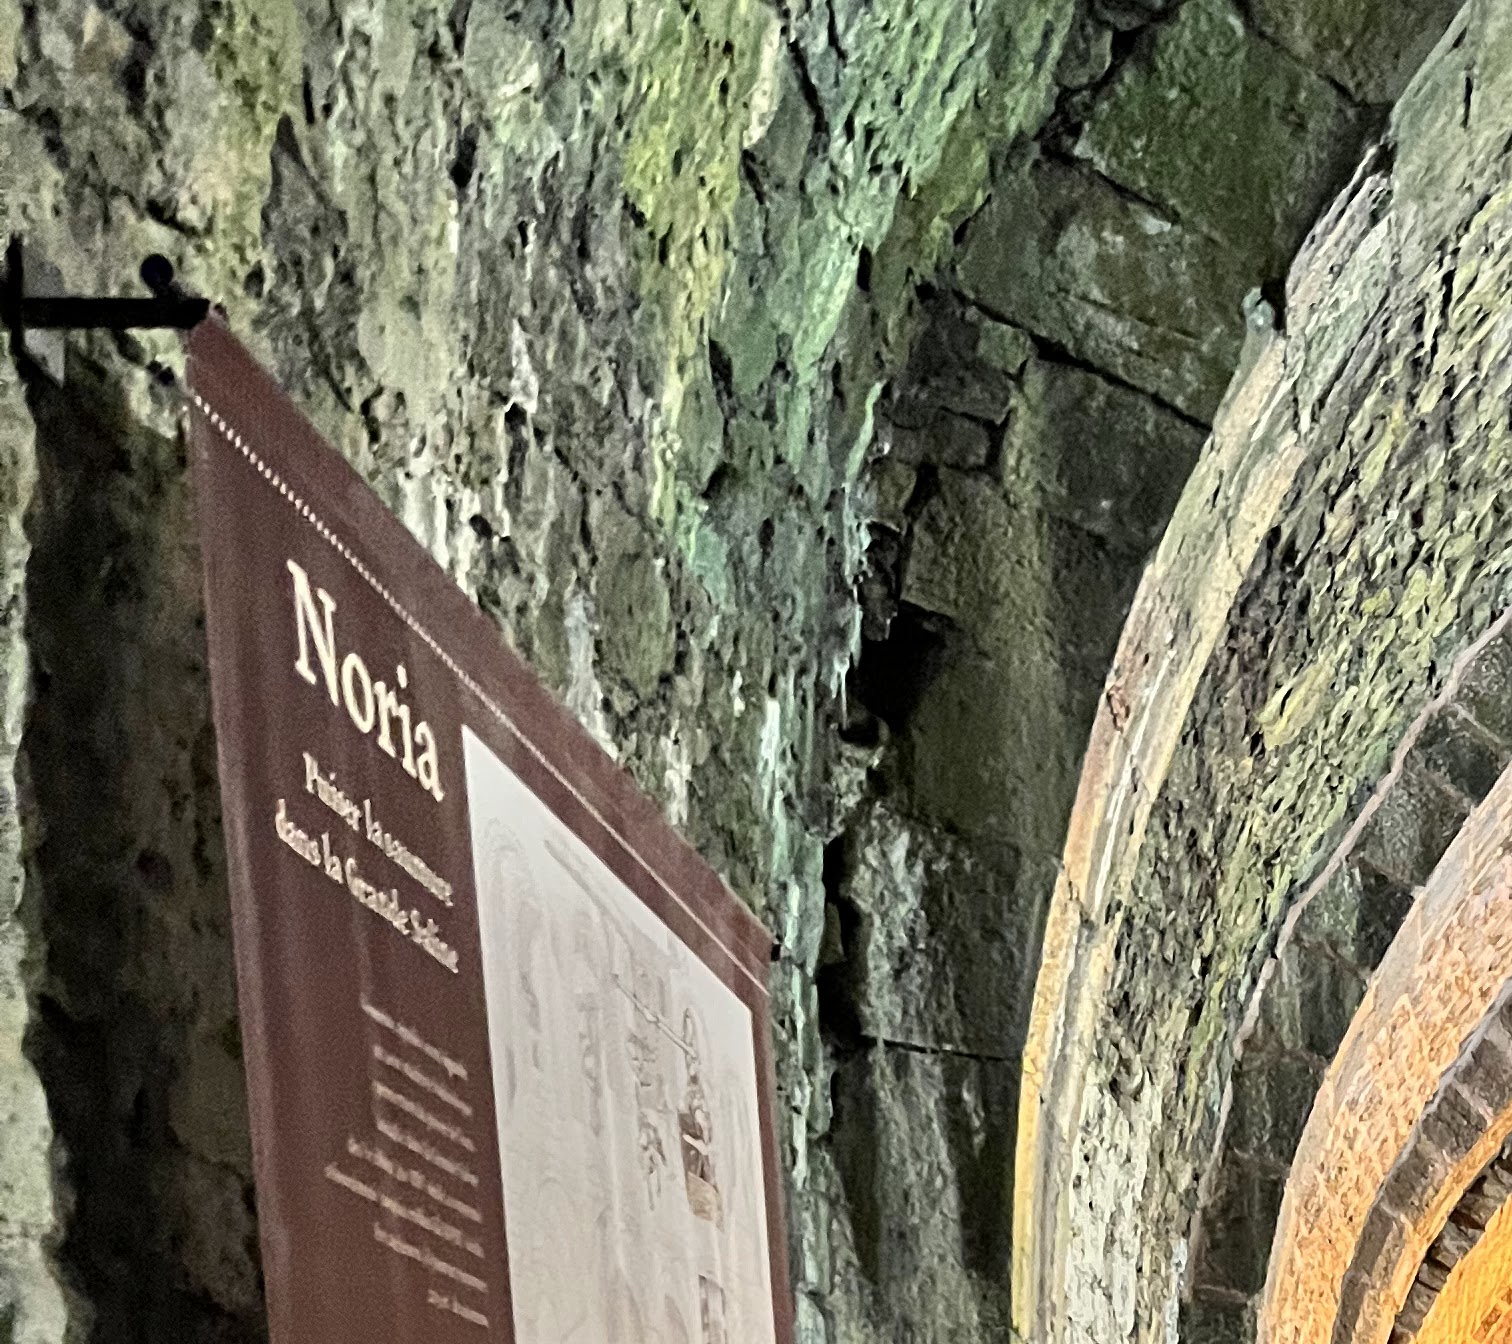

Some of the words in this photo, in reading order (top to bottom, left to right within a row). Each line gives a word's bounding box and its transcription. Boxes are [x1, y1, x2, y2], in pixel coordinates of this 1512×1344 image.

[286, 558, 446, 802] Noria
[275, 799, 321, 867] dans
[321, 832, 344, 884] la
[345, 857, 410, 936] Grande
[363, 799, 384, 850] la
